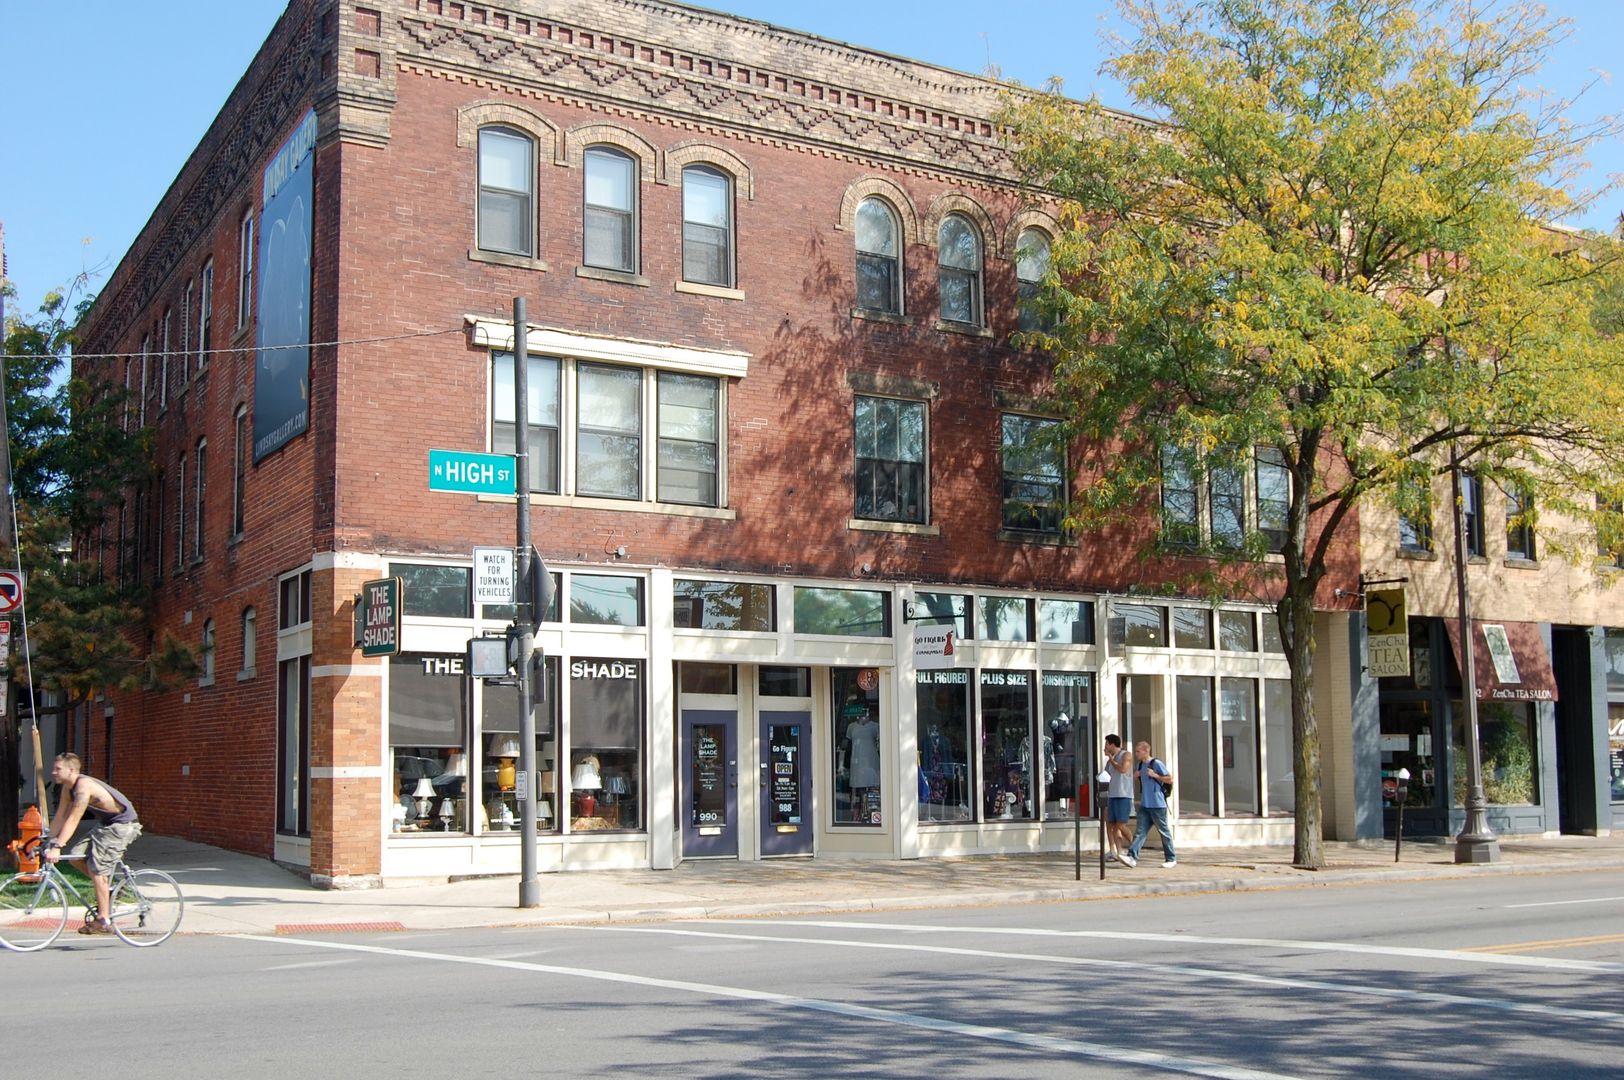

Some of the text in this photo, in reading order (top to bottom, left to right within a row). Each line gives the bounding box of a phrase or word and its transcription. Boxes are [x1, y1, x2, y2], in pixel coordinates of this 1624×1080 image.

[434, 461, 510, 485] N HIGH ST
[483, 555, 505, 564] WATCH
[488, 566, 500, 574] FOR
[480, 577, 509, 586] TURNING
[370, 585, 389, 605] THE
[478, 588, 511, 596] VEHICLES
[367, 606, 392, 626] LAMP
[364, 626, 395, 647] SHADE
[1369, 636, 1404, 647] ZenCha
[1370, 648, 1404, 663] TEA
[421, 658, 637, 679] THE SHADE
[1371, 663, 1405, 675] SALON
[934, 672, 968, 684] FIGURED
[981, 673, 1027, 686] PLUS SIZE
[1492, 689, 1515, 698] ZenCha
[1515, 689, 1529, 698] TEA
[1529, 689, 1552, 699] SALON
[777, 764, 793, 773] OPEN
[779, 803, 792, 812] 988
[699, 812, 718, 821] 990
